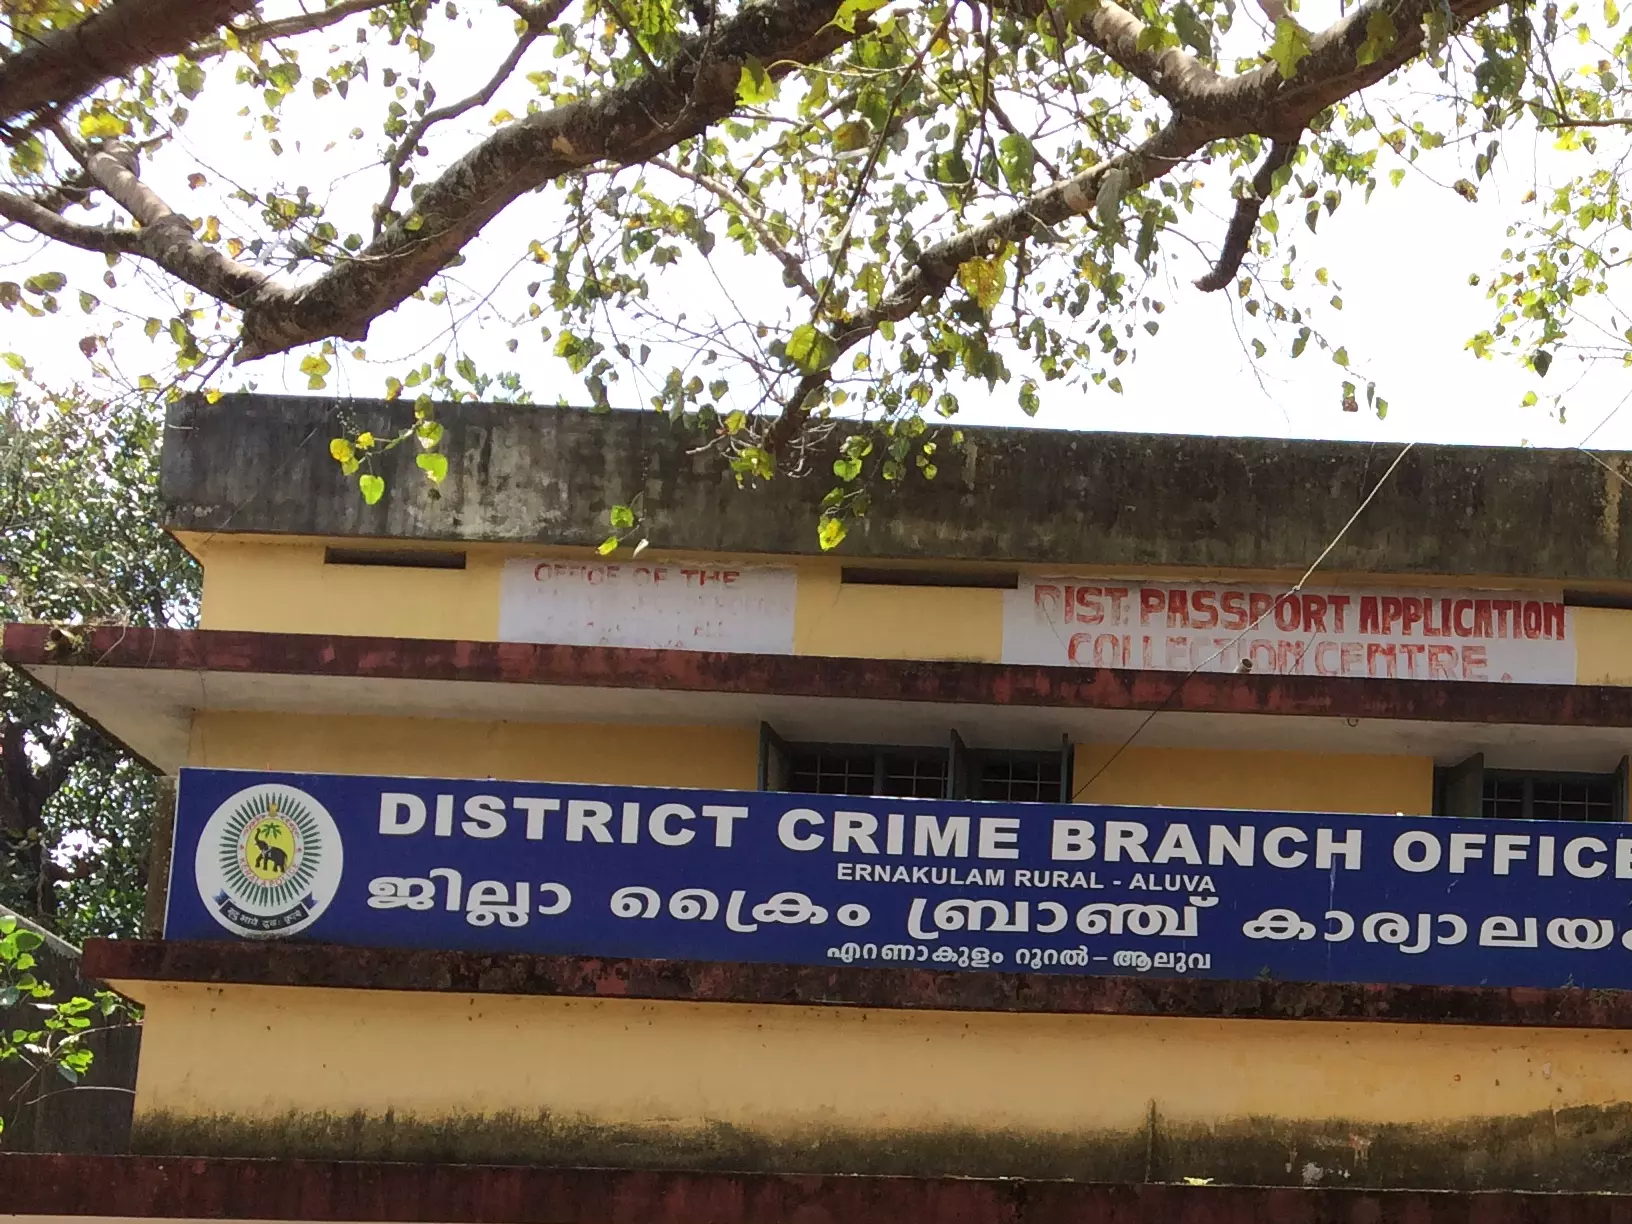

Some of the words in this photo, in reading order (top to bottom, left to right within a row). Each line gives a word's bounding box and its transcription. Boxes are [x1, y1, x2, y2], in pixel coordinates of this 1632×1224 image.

[680, 569, 740, 589] THE
[1140, 588, 1350, 634] PASSPORT
[1359, 596, 1565, 641] APPLICATION
[377, 792, 749, 849] DISTRICT
[777, 808, 1021, 860] CRIME
[1051, 818, 1363, 871] BRANCH
[836, 862, 1006, 888] ERNAKULAM
[1014, 866, 1104, 890] RURAL
[1129, 874, 1216, 893] ALUVA
[367, 867, 571, 929] ജില്ലാ
[610, 885, 871, 933] ക്രൈം
[826, 940, 1004, 969] എറണാകുളം
[1113, 949, 1212, 974] ആലുവ
